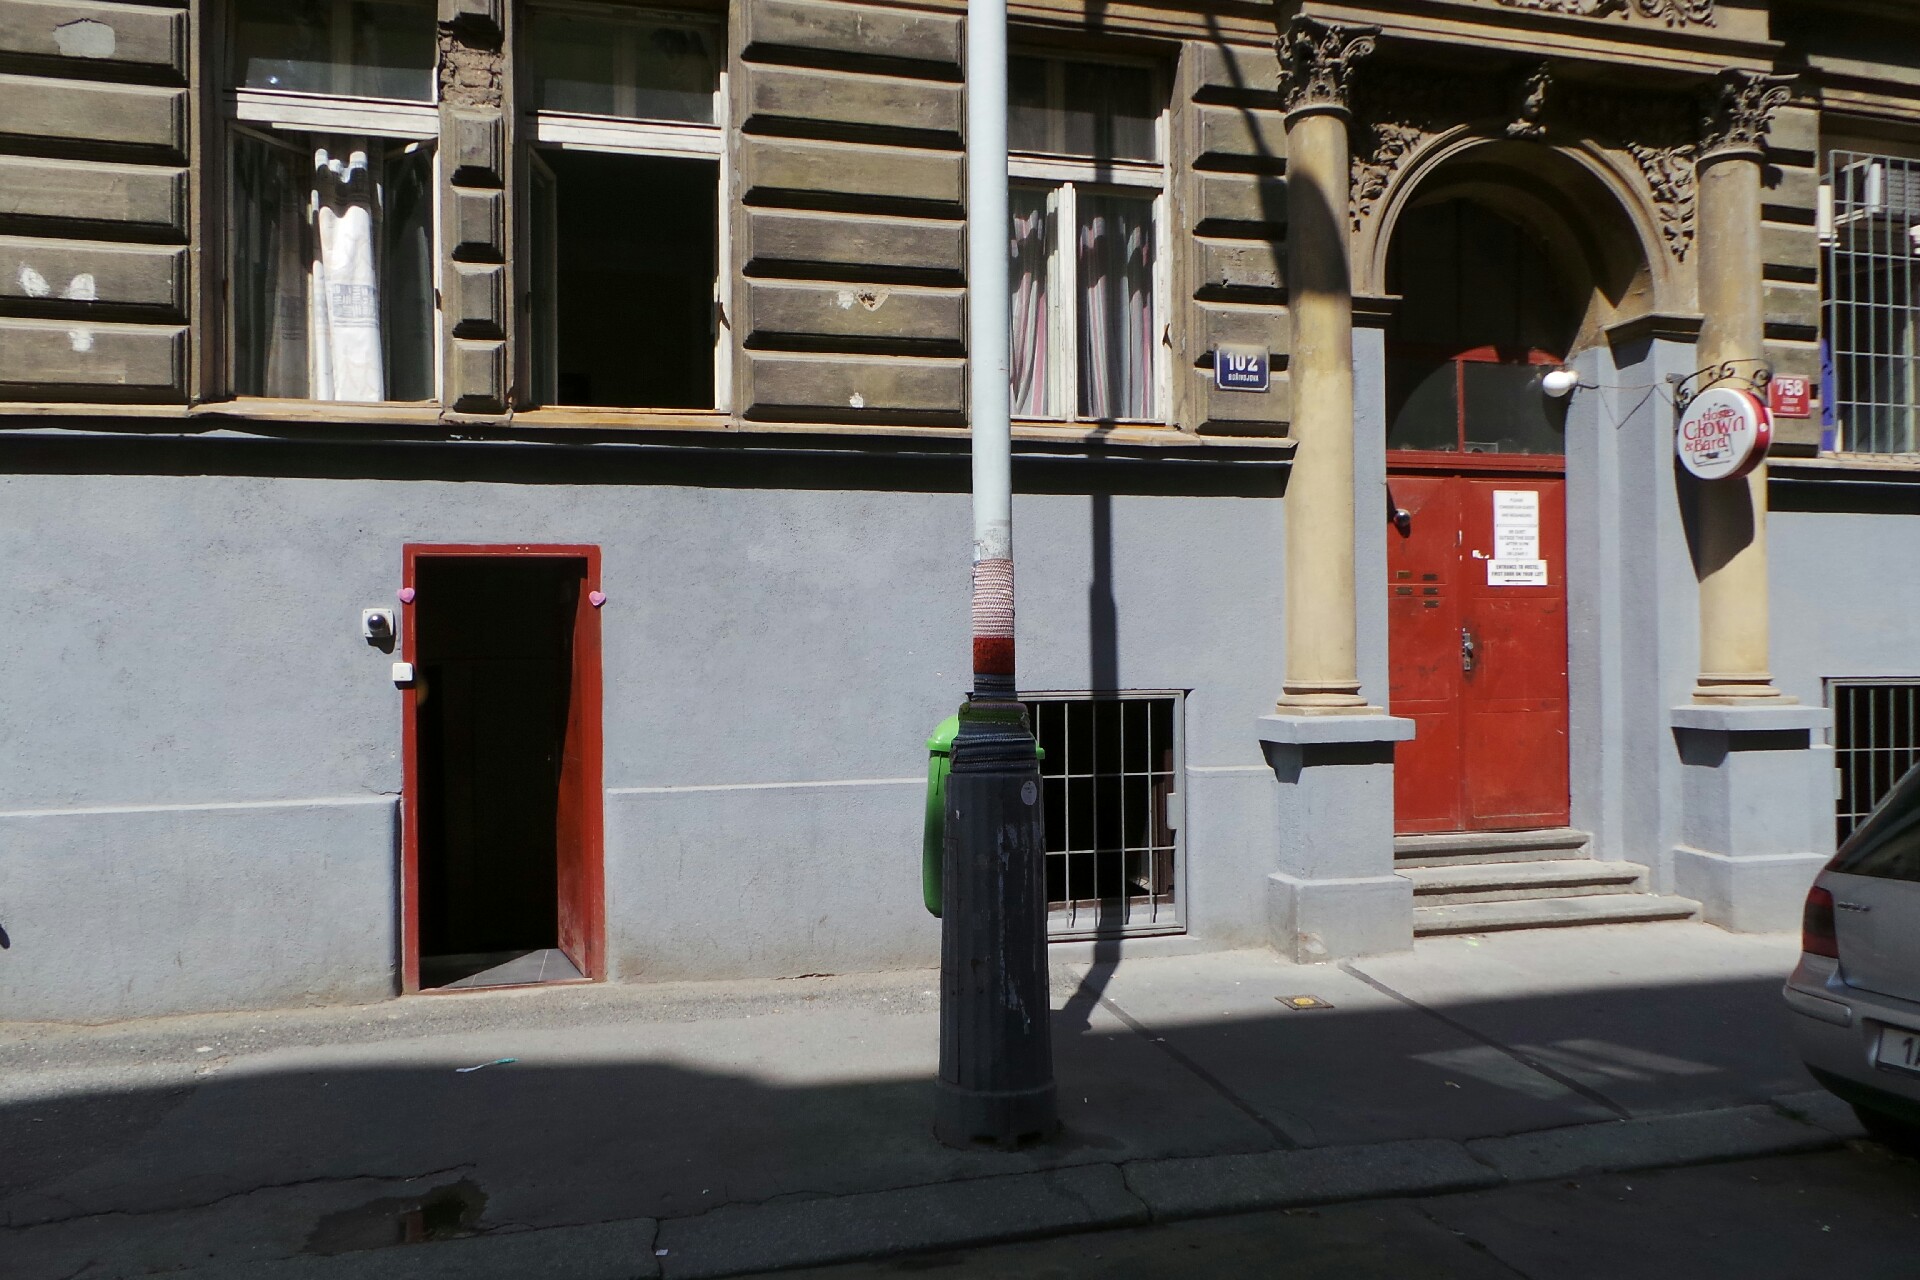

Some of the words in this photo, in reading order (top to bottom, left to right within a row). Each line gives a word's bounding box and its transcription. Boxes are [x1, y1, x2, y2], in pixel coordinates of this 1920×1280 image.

[1226, 352, 1258, 371] 102
[1776, 379, 1804, 396] 758
[1683, 416, 1746, 441] Clown
[1694, 434, 1728, 452] Bard
[1903, 1037, 1920, 1067] 1
